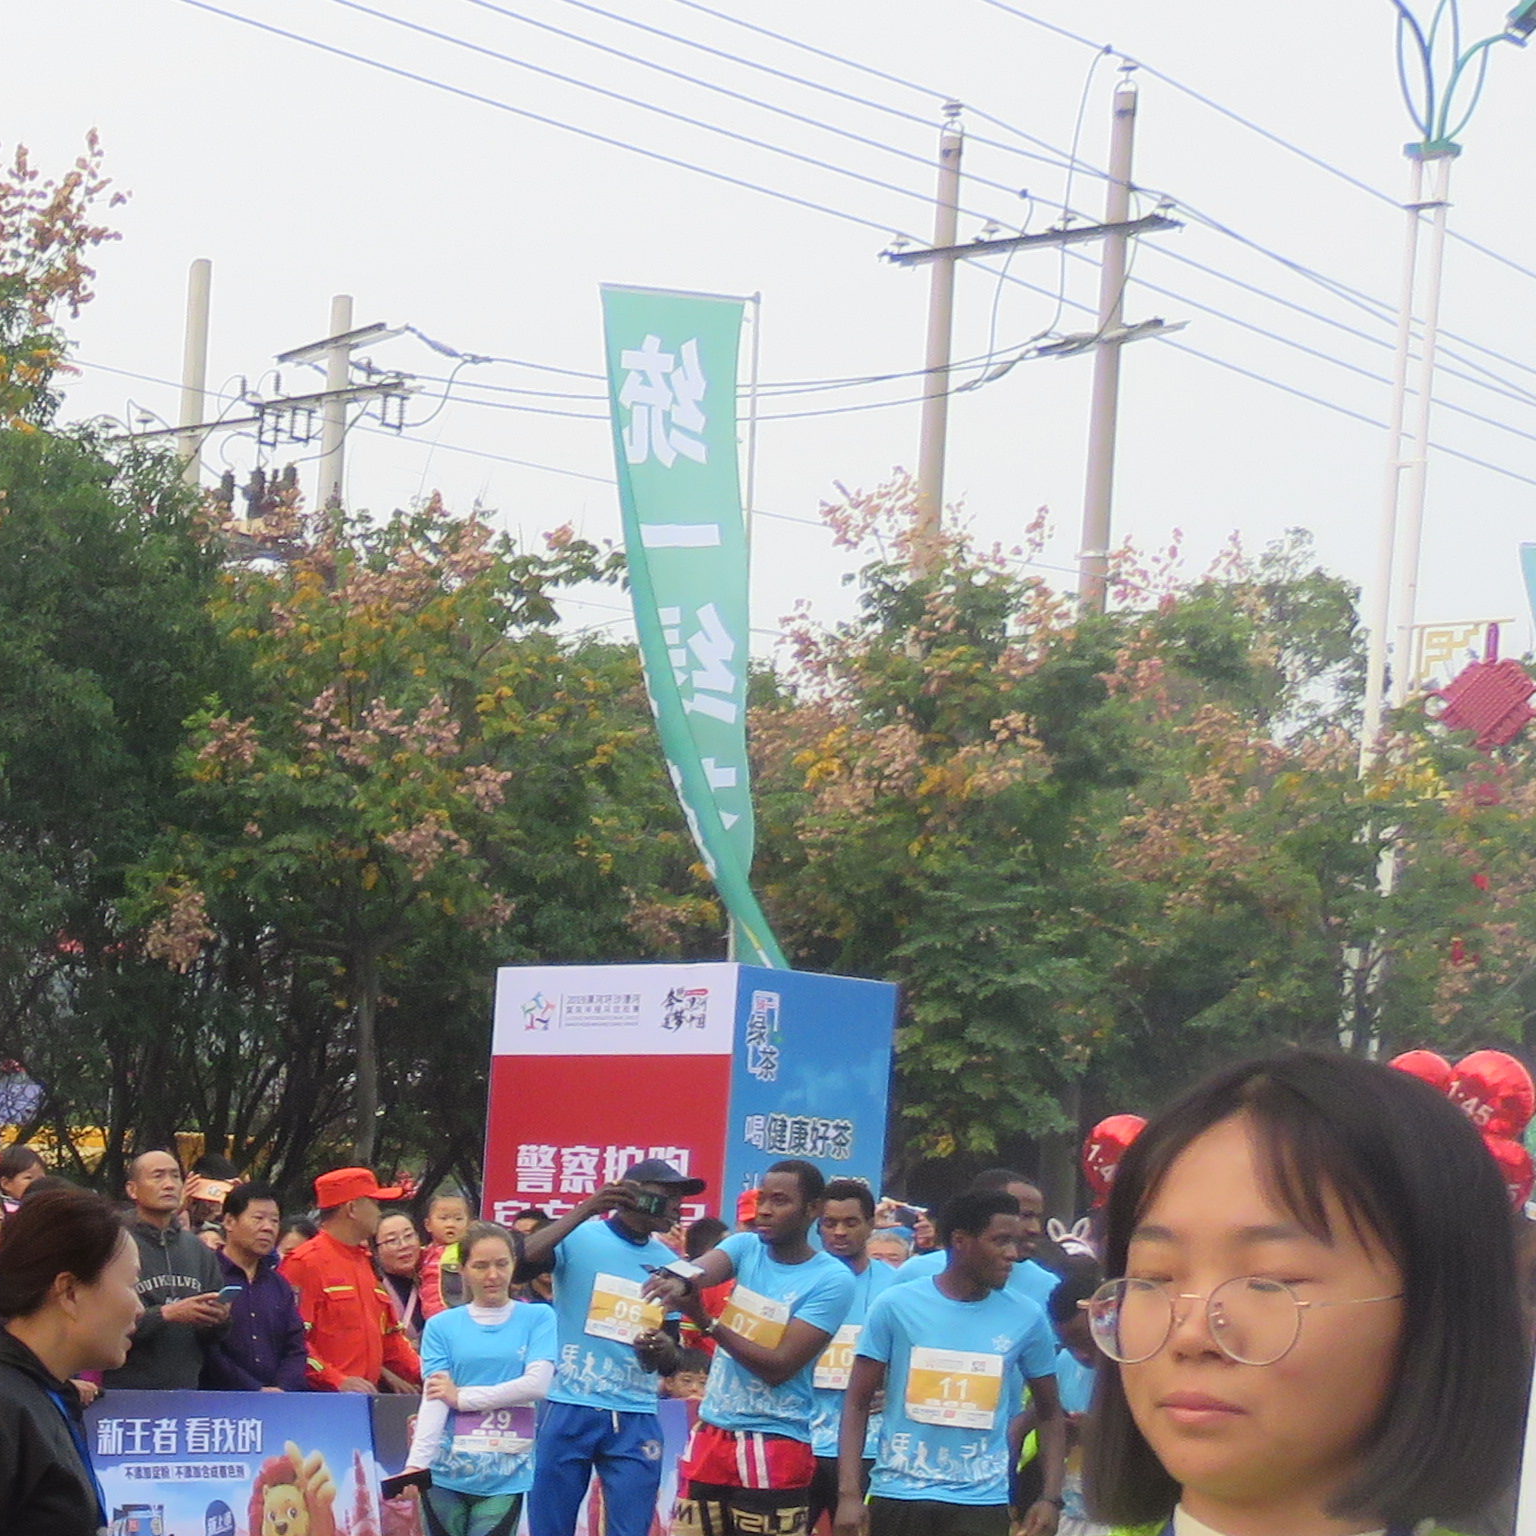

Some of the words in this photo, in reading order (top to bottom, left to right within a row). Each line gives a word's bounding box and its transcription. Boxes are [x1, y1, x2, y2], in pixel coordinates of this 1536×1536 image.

[745, 1113, 852, 1160] 喝健康好茶
[614, 1299, 642, 1323] 06
[938, 1377, 969, 1400] 11
[480, 1410, 512, 1430] 29
[96, 1418, 178, 1456] 新王者
[185, 1417, 263, 1455] 看我的
